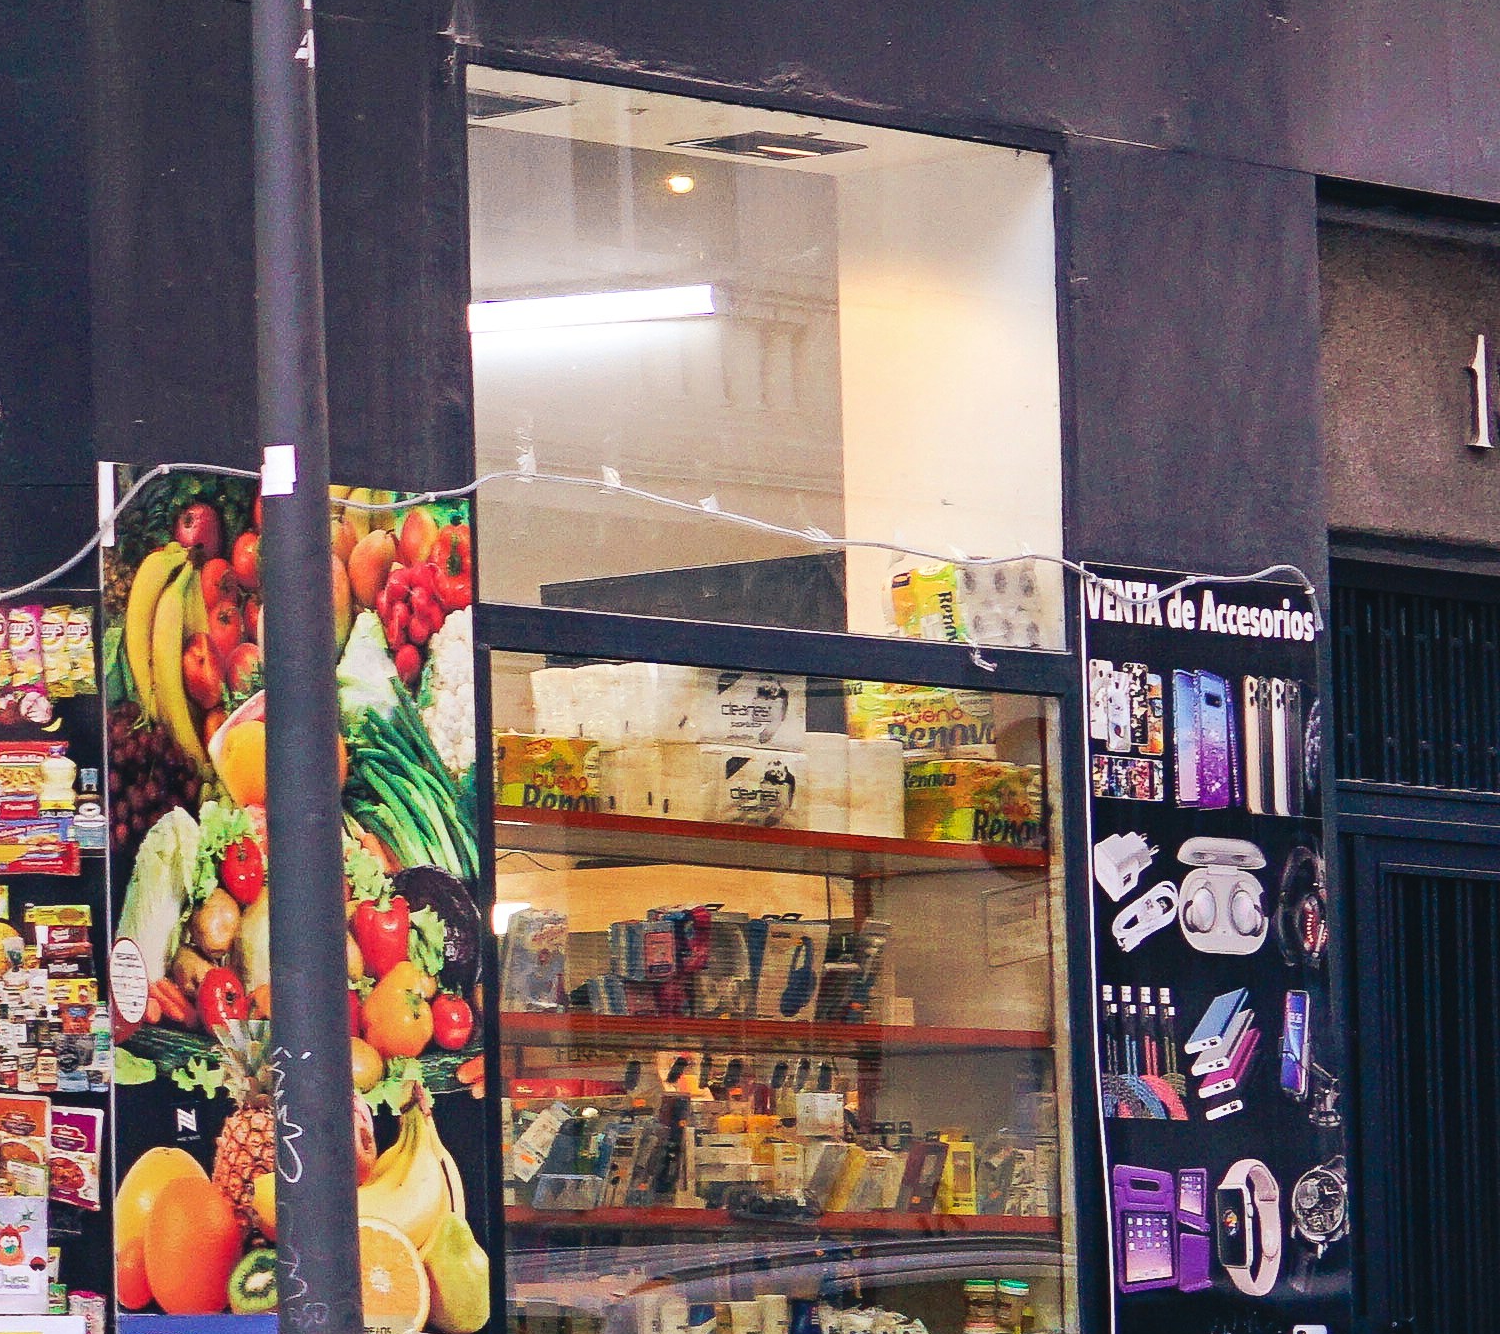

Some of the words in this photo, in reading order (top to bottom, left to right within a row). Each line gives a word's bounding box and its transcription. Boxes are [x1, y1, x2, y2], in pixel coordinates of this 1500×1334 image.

[1085, 579, 1163, 627] VENTA
[1167, 588, 1196, 630] de
[1201, 589, 1315, 642] Accesorios
